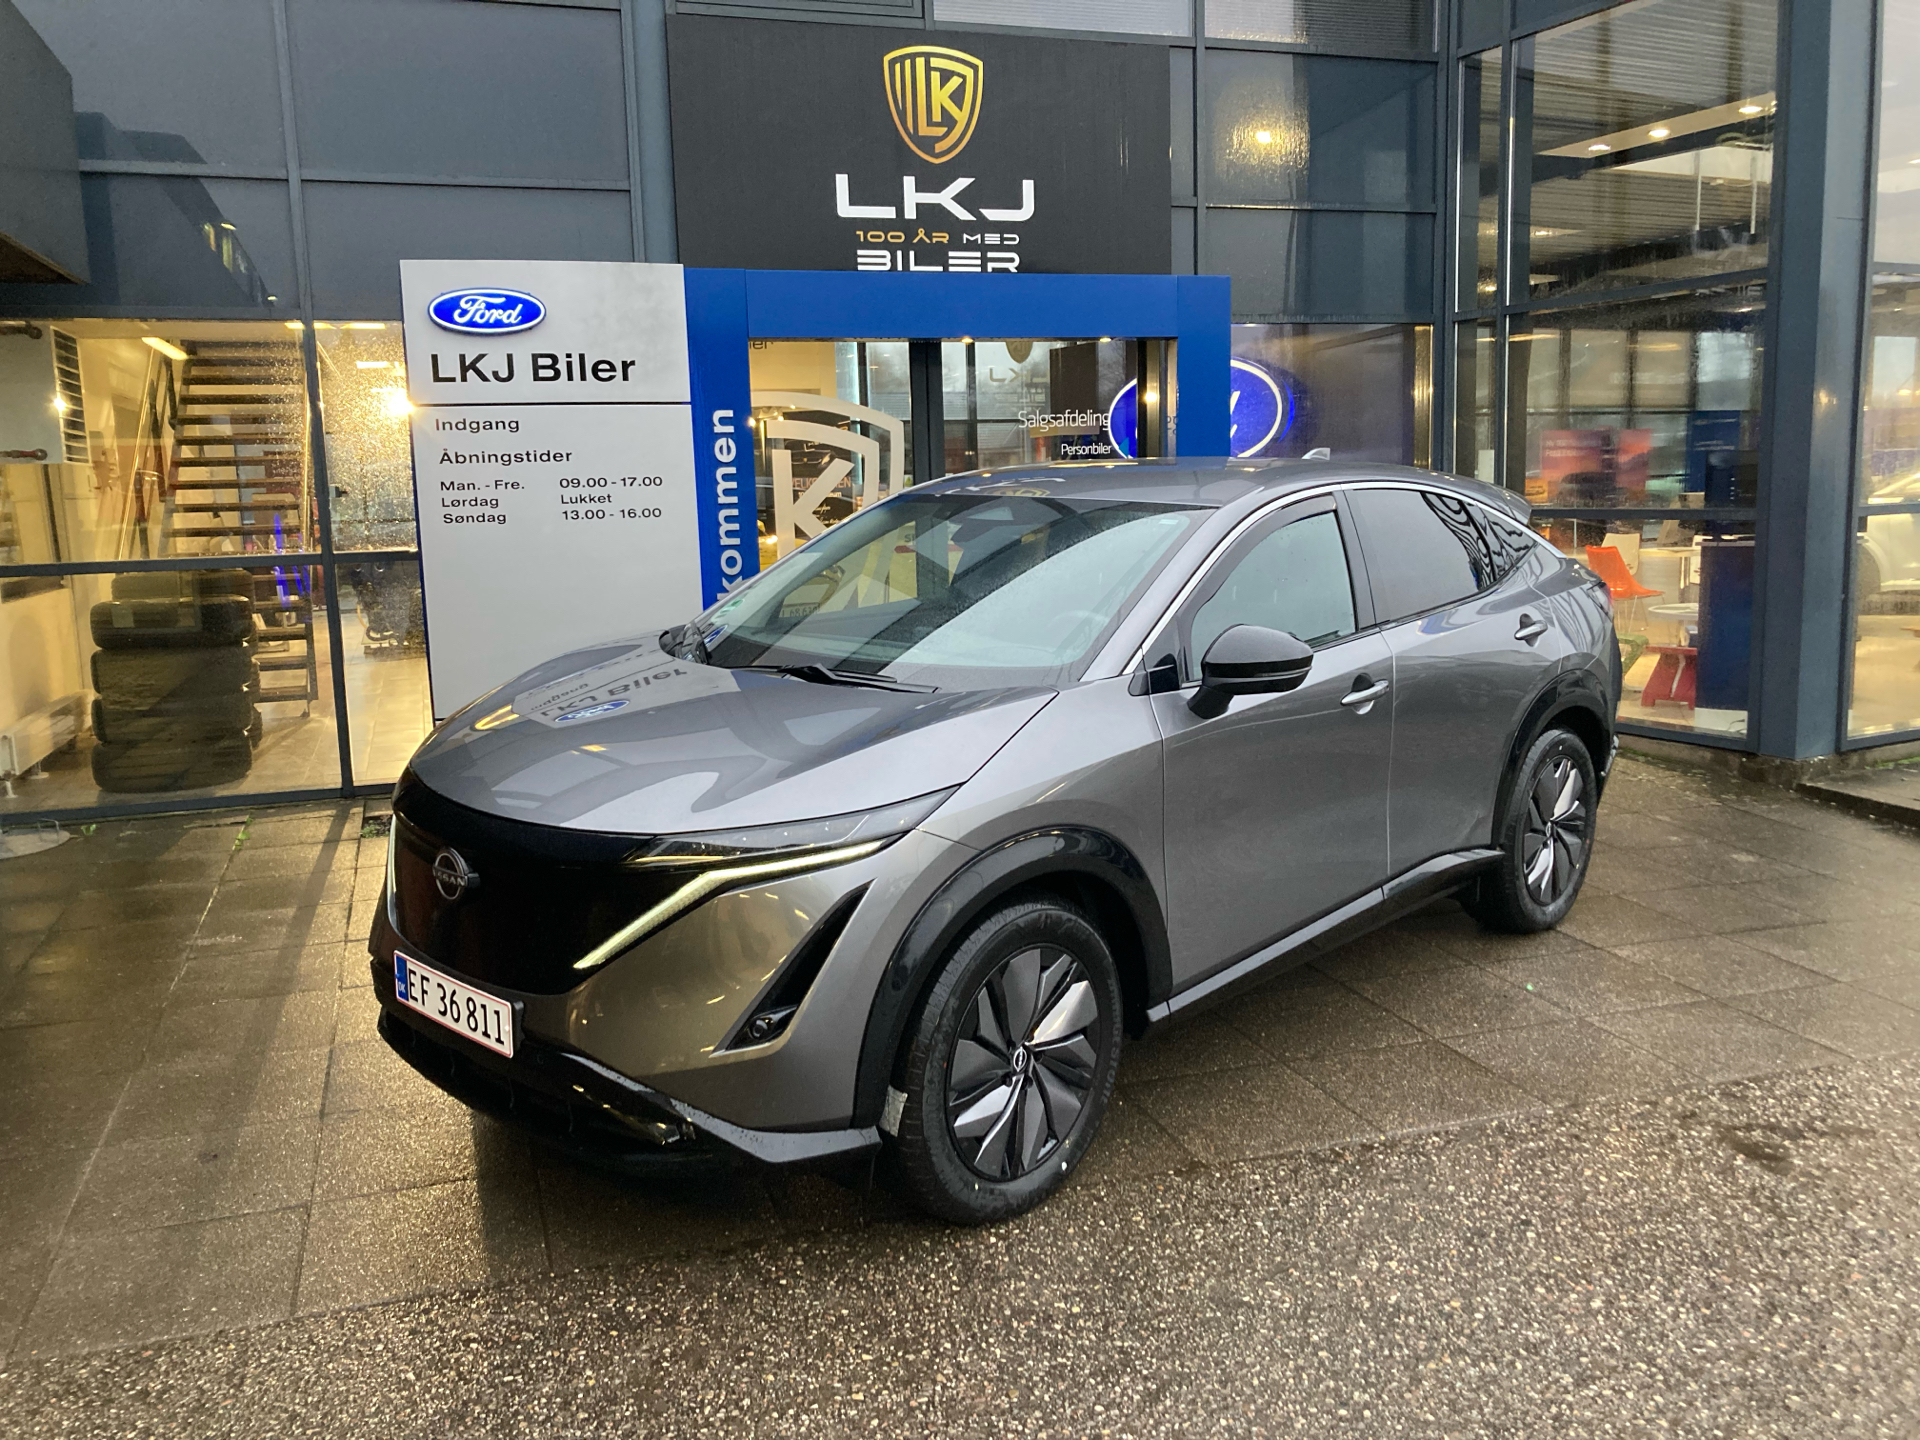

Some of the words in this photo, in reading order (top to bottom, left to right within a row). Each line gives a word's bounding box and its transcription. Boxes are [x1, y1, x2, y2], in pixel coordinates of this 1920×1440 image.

[835, 173, 1035, 222] LKJ
[855, 230, 906, 243] 100
[912, 228, 949, 244] ÅR
[962, 233, 1020, 245] MED
[856, 249, 1020, 272] BILER
[453, 295, 523, 324] Ford
[430, 353, 515, 383] LKJ
[531, 353, 636, 382] Biler
[435, 417, 520, 433] Indgang
[1018, 408, 1111, 432] Salgsafdeling
[439, 448, 573, 466] Åbningstider
[1061, 443, 1112, 456] Personbiler
[440, 480, 481, 491] Man.
[494, 479, 525, 491] Fre.
[441, 496, 500, 510] Lørdag
[561, 493, 612, 505] Lukket
[443, 511, 507, 525] Søndag
[407, 968, 430, 1007] EF
[437, 982, 461, 1024] 36
[466, 996, 505, 1046] 811
